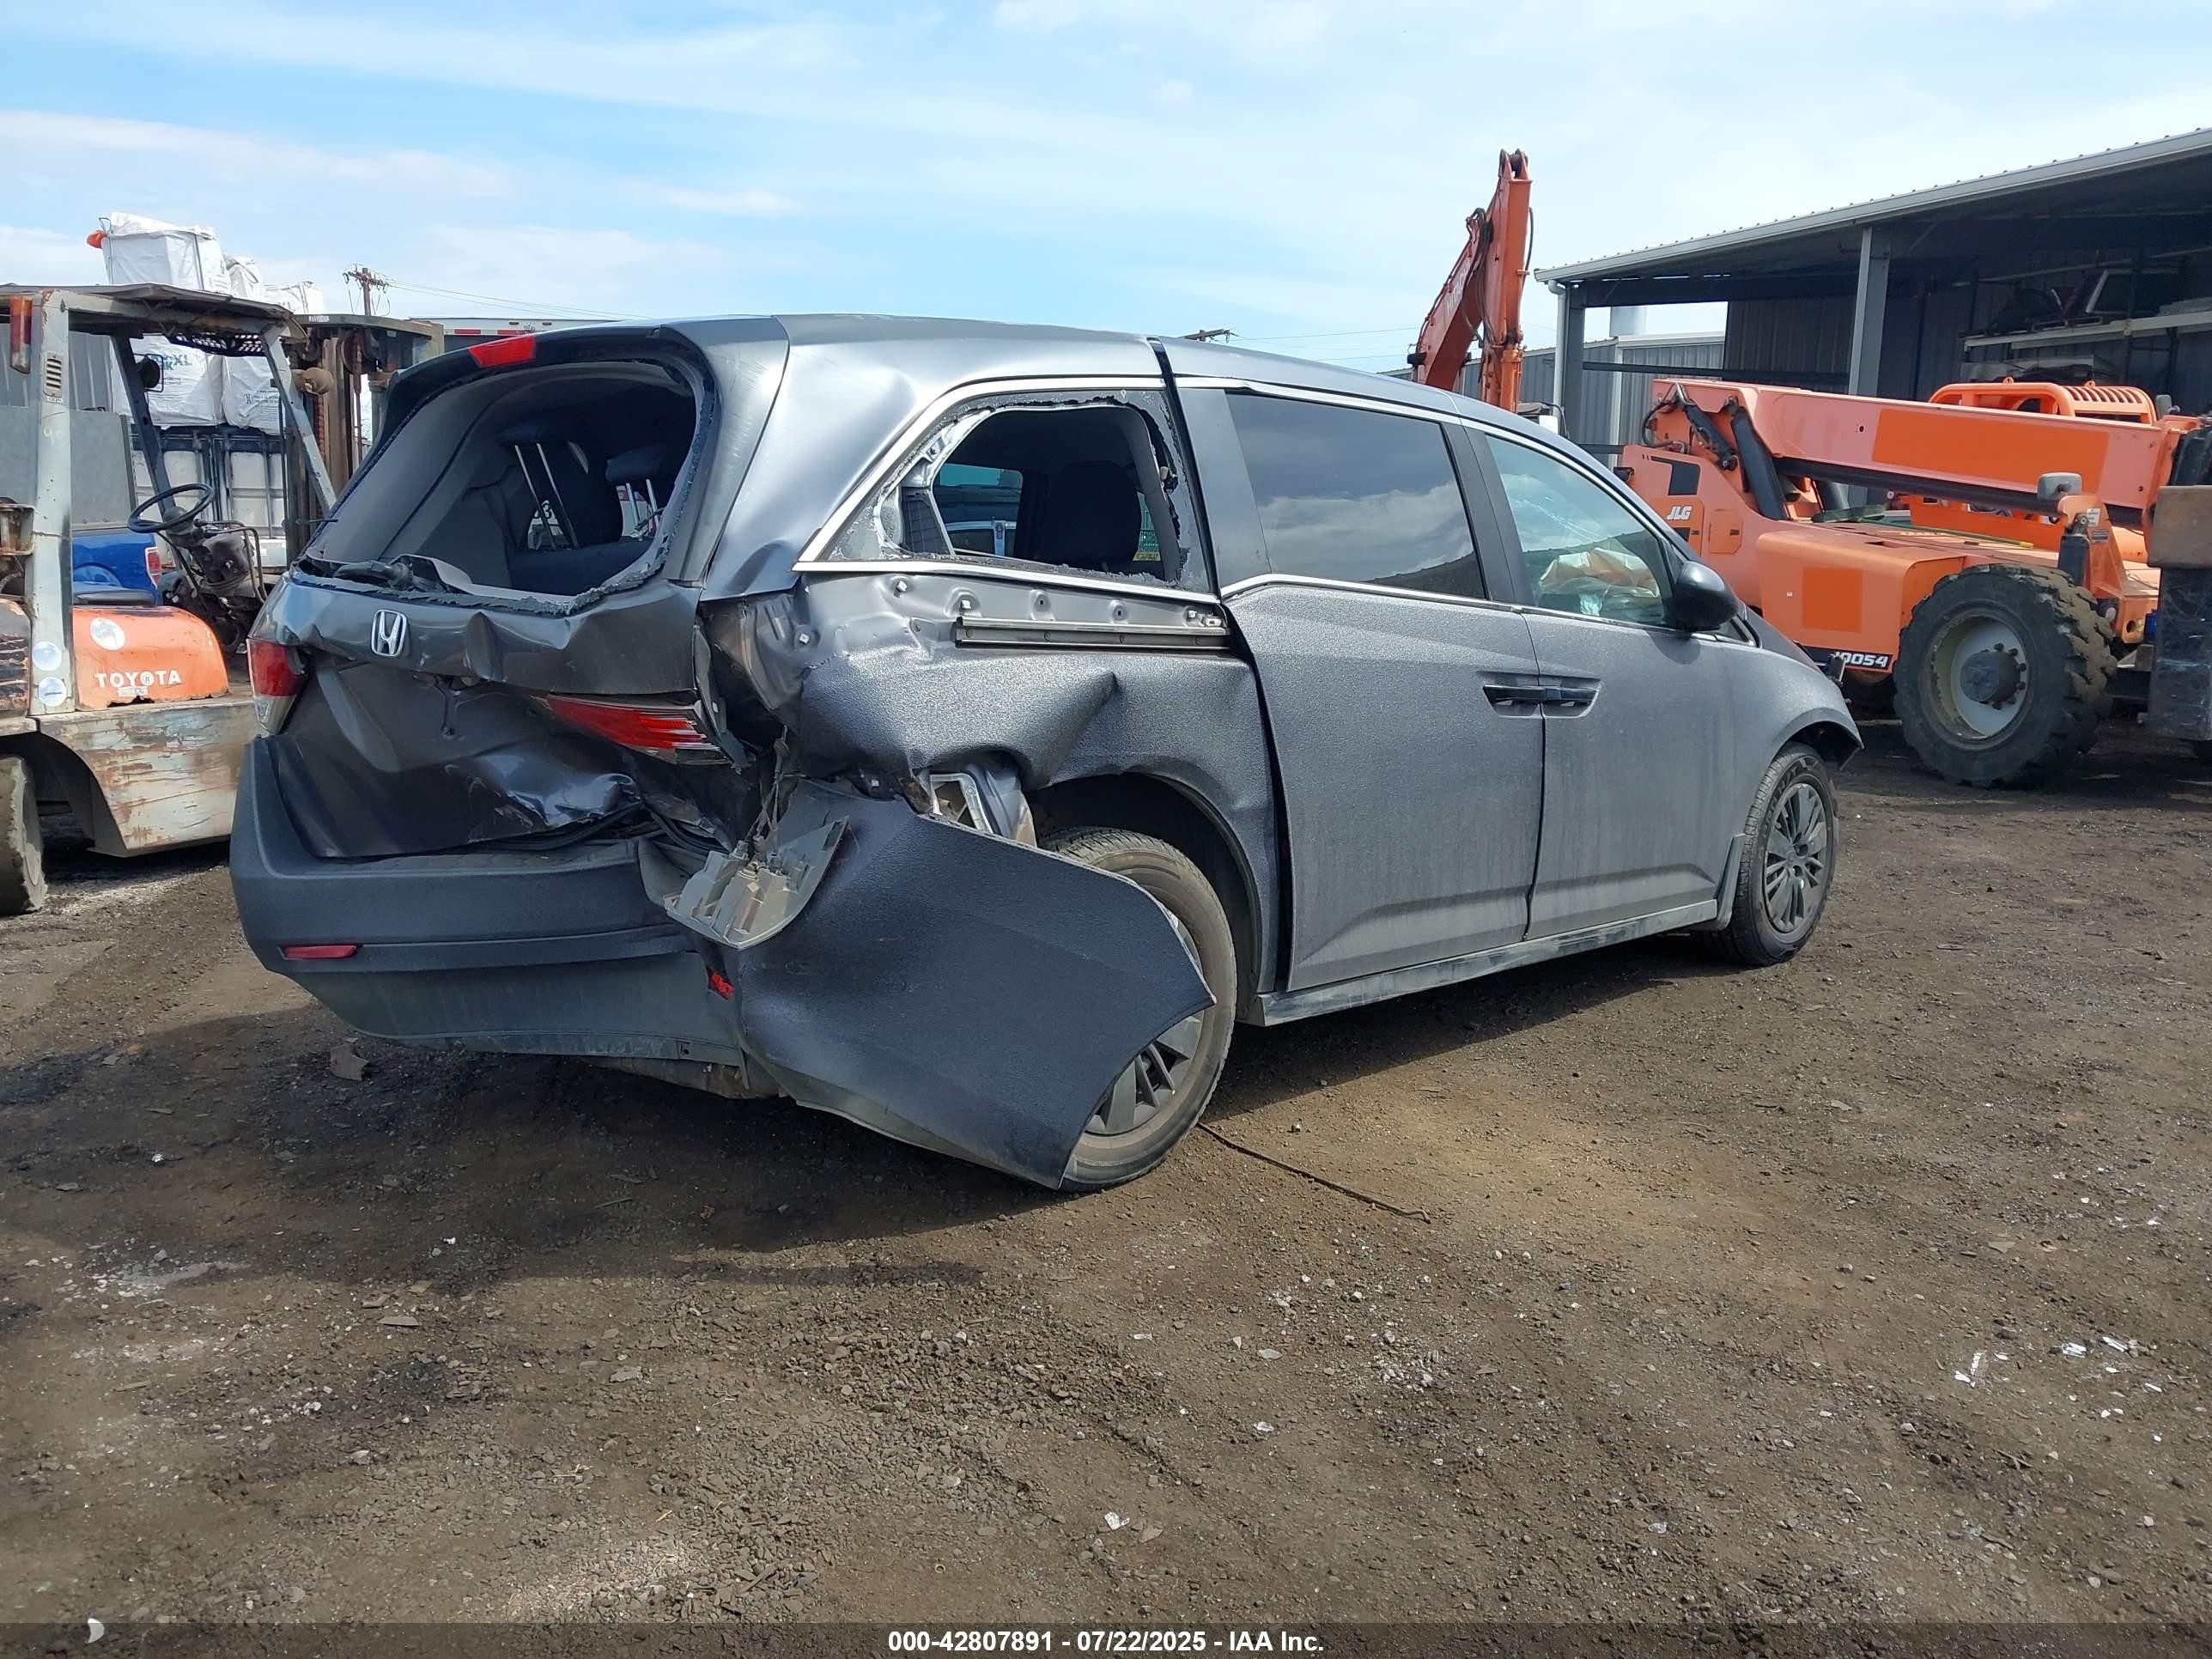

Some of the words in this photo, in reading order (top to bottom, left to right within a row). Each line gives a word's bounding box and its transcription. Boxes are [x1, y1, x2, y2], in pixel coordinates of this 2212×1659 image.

[1666, 506, 1693, 520] JLG
[1836, 653, 1888, 667] 0054
[94, 670, 181, 688] TOYOTA
